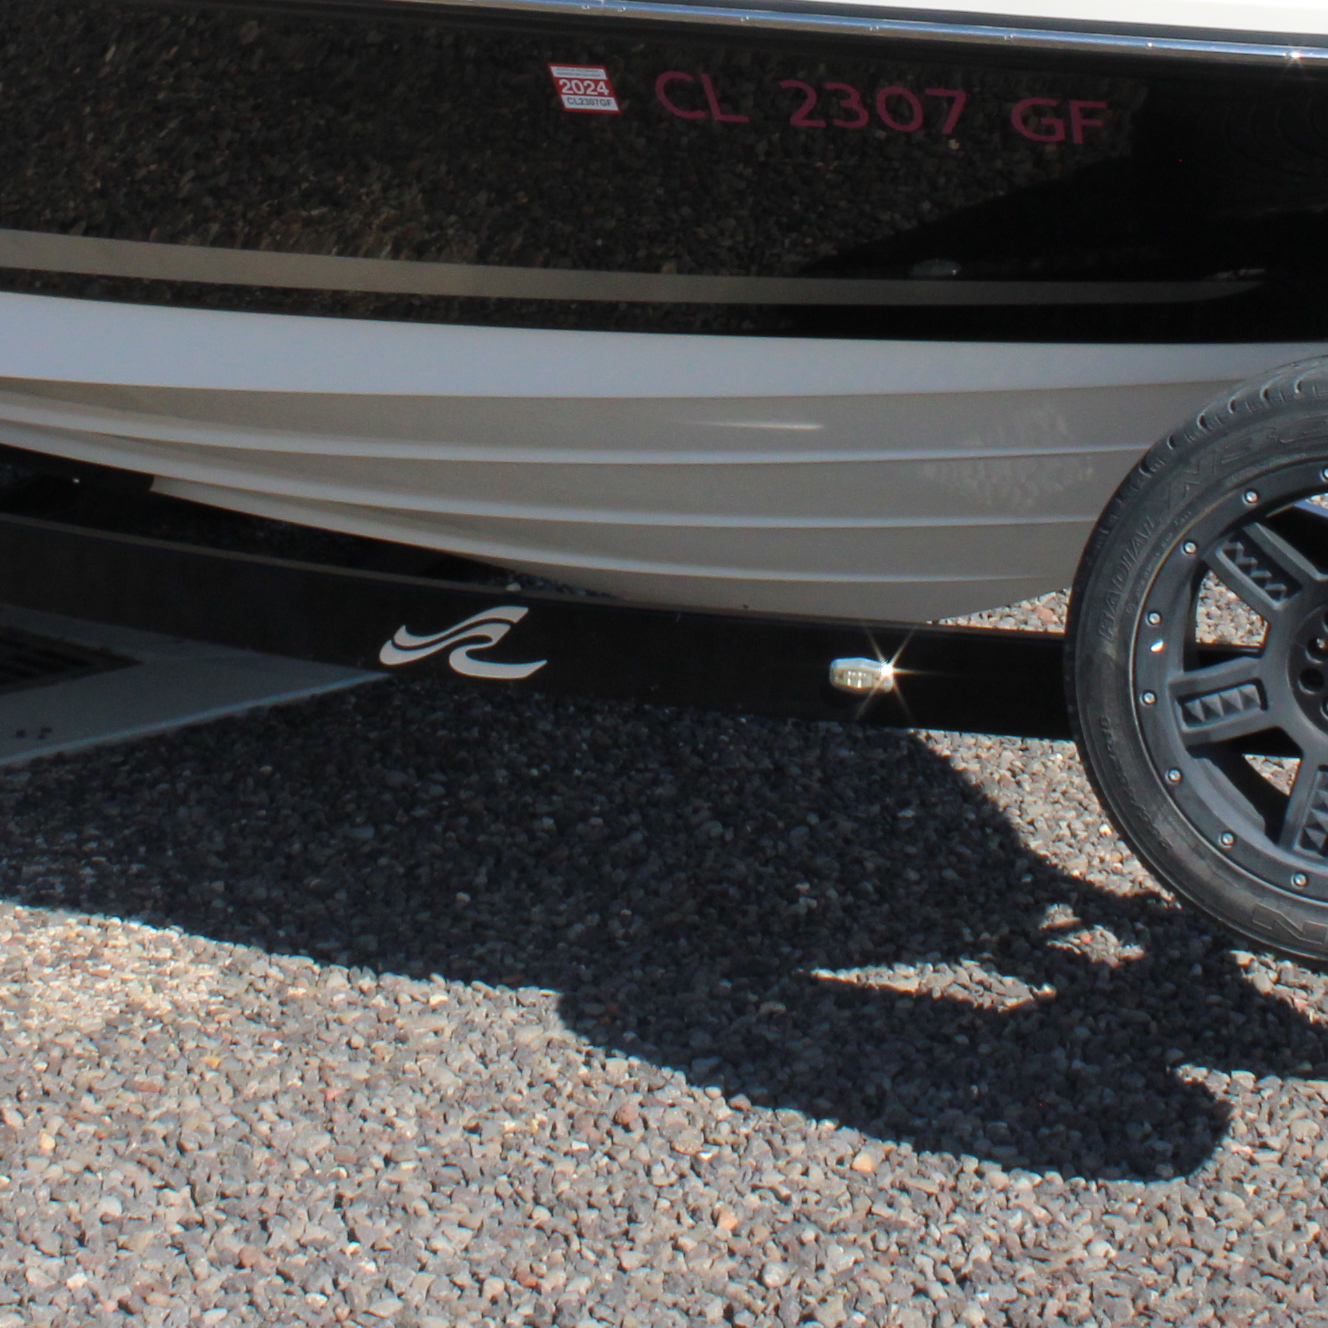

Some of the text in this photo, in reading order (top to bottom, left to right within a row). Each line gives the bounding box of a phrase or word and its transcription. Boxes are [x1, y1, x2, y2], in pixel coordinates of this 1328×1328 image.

[559, 78, 610, 96] 2024
[567, 97, 613, 107] CL2307GF
[654, 70, 1108, 145] CL 2307 GF
